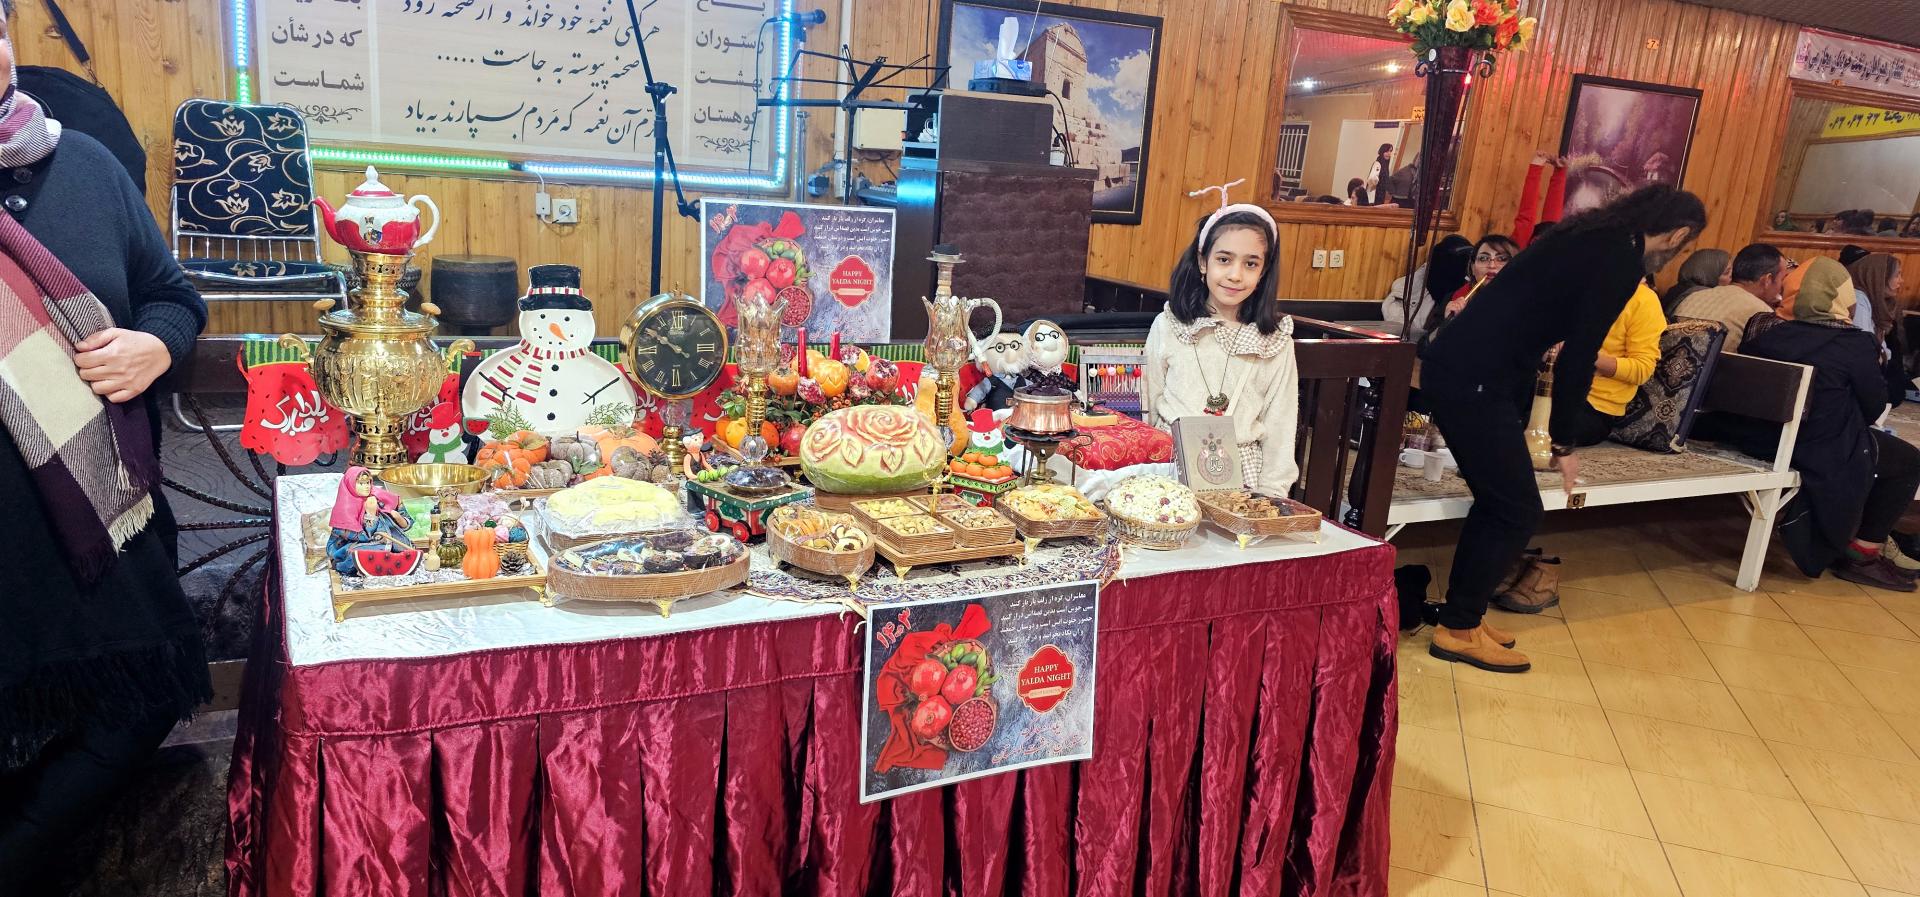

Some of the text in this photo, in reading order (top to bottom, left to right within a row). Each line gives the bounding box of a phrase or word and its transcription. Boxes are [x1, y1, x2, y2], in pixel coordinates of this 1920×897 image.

[502, 10, 512, 23] و
[559, 4, 582, 31] خود
[271, 16, 363, 48] که در شأن
[642, 25, 660, 41] هر
[695, 28, 764, 54] رستوران
[553, 66, 563, 84] به
[610, 55, 640, 78] صحنه
[273, 69, 364, 91] شماست
[695, 70, 763, 93] بهشت
[404, 99, 425, 132] یاد
[440, 99, 525, 140] بسپارند
[560, 92, 594, 132] که
[584, 99, 609, 133] نغمه
[693, 106, 762, 131] کوهستان
[607, 109, 642, 144] آن
[260, 395, 315, 436] مبارک
[294, 390, 330, 423] یلدا
[1572, 495, 1580, 506] 6
[1021, 672, 1072, 686] YALDA NIGHT
[1034, 663, 1059, 674] HAPPY
